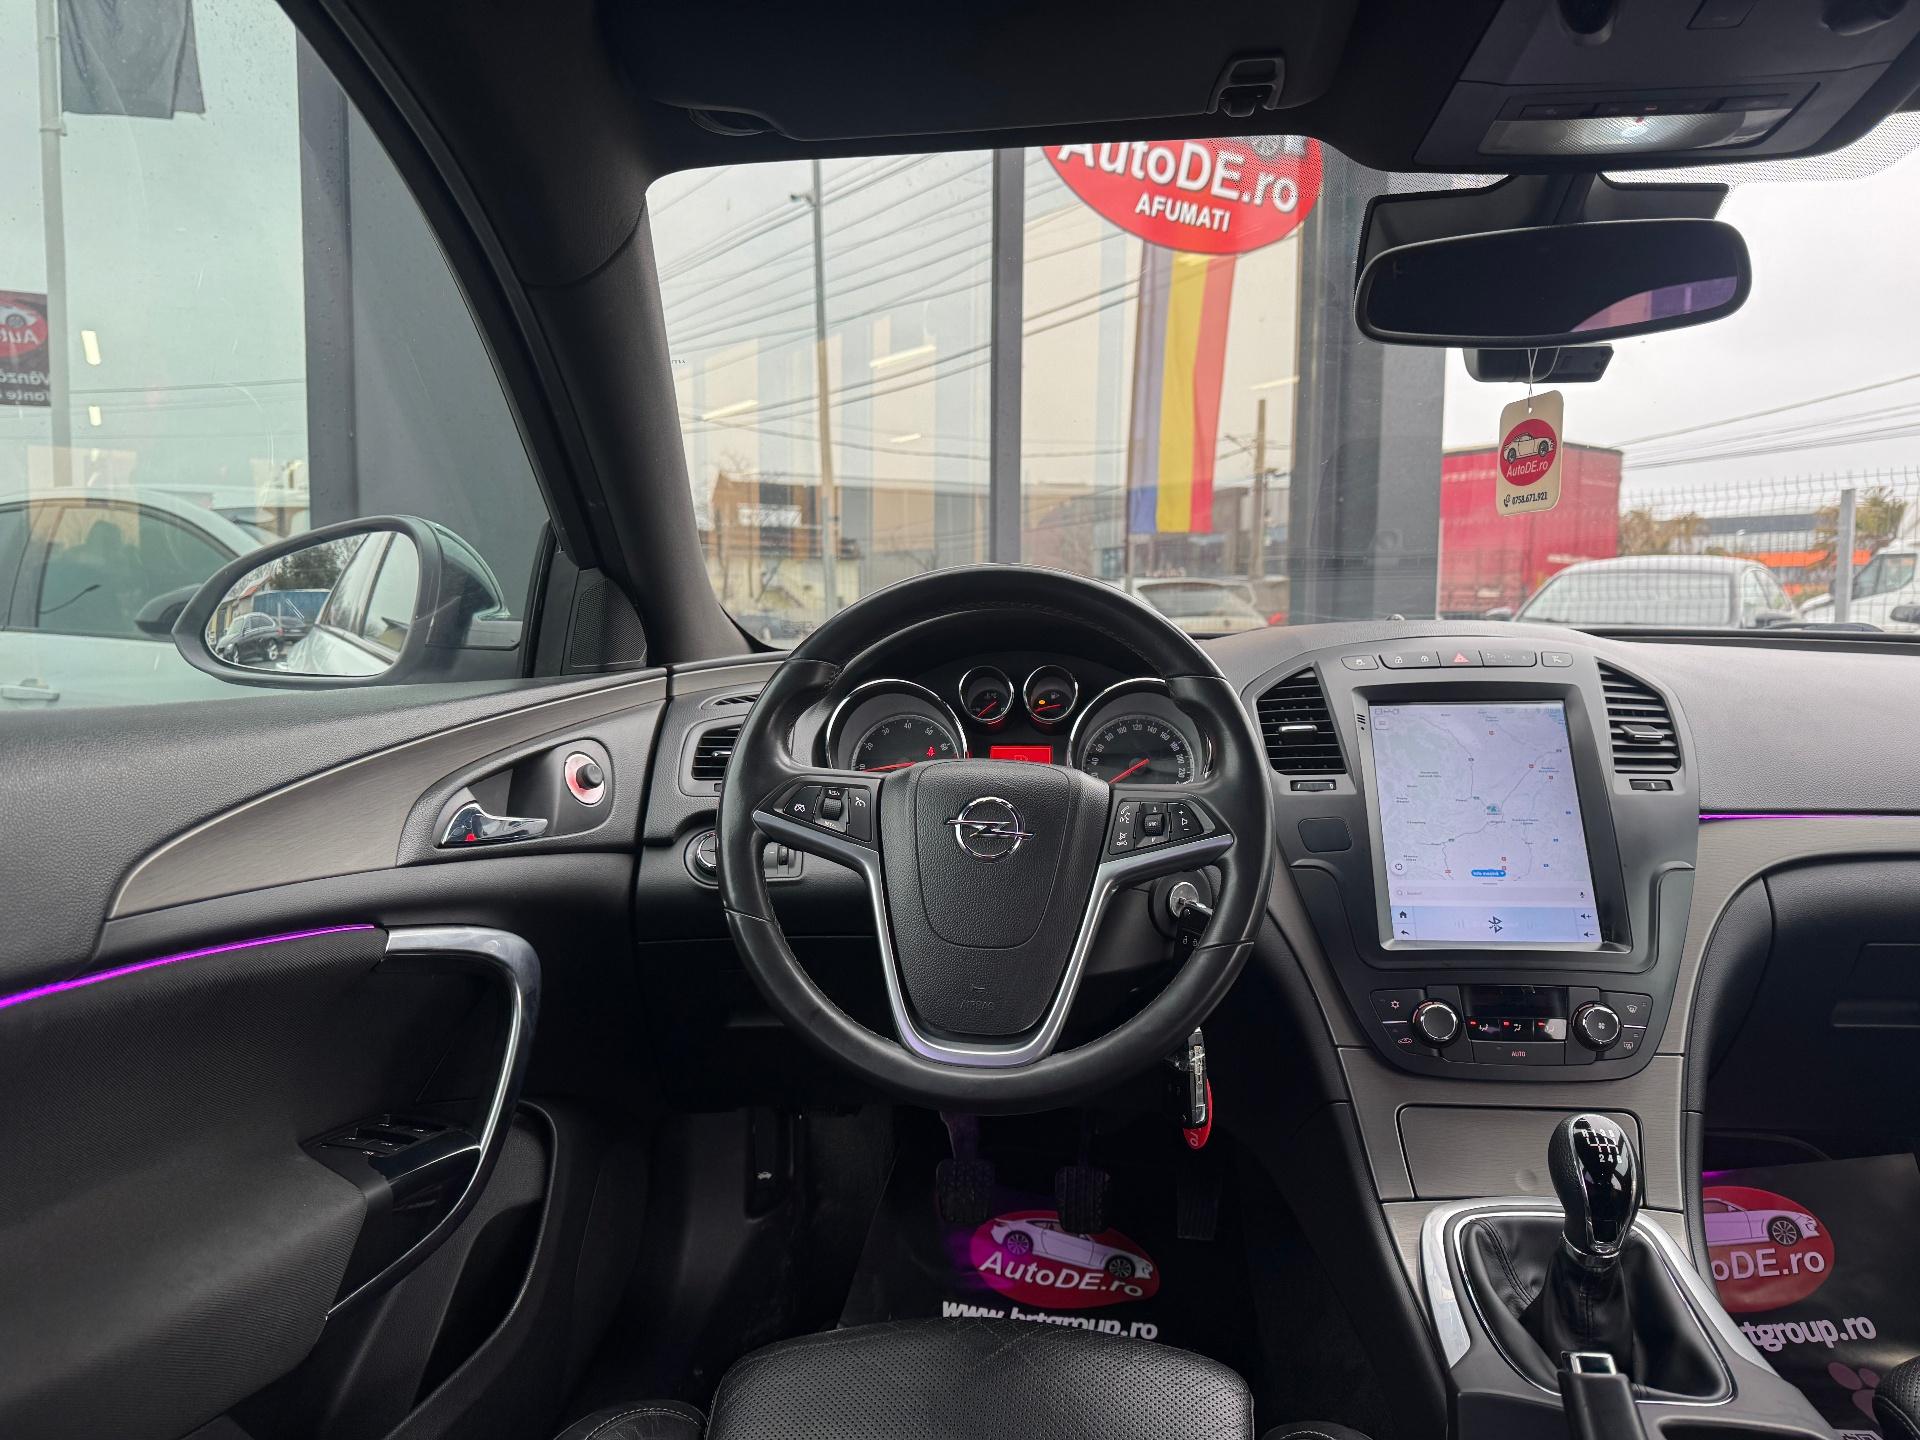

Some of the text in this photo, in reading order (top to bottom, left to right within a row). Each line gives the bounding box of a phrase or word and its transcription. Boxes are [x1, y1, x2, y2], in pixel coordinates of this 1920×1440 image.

[1056, 140, 1300, 213] AutoDE.ro
[1135, 192, 1231, 233] AFUMATI
[1506, 460, 1549, 478] AutoDE.ro
[1599, 1154, 1606, 1162] 2
[1608, 1154, 1614, 1163] 4
[979, 1251, 1143, 1297] AutoDE.ro
[942, 1301, 1159, 1340] wwwbtroup.ro
